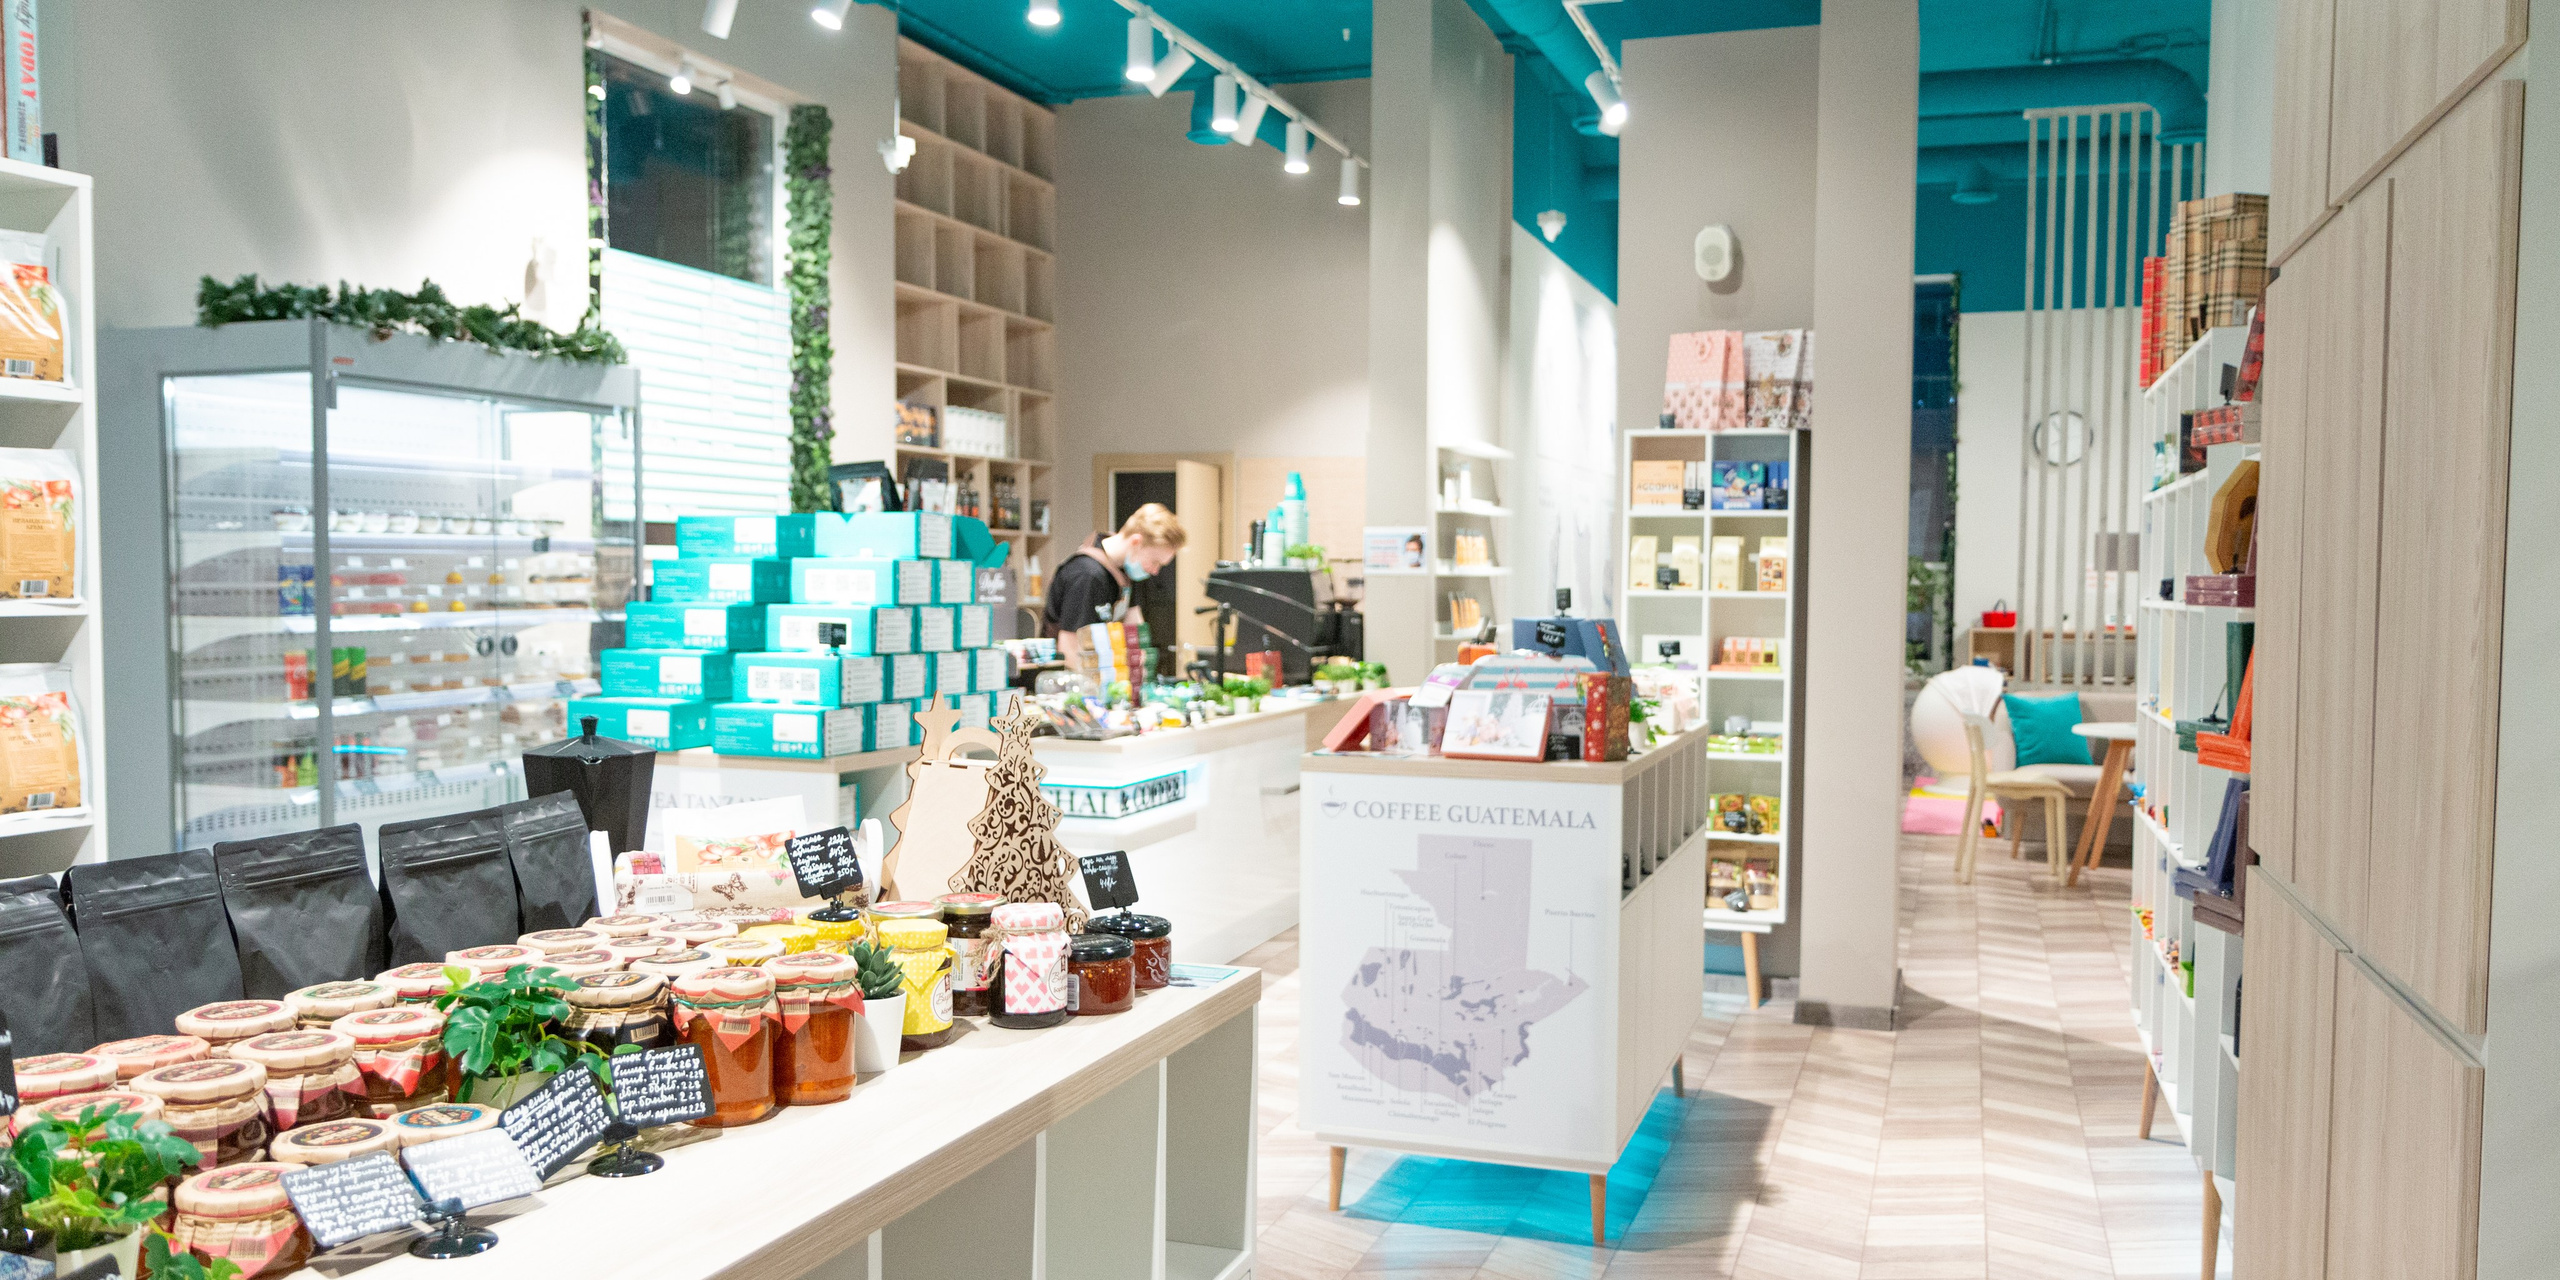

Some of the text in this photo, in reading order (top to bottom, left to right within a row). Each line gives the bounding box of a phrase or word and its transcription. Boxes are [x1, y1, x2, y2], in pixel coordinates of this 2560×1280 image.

[19, 30, 37, 101] TODAY
[1353, 800, 1597, 830] COFFEE GUATEMALA
[681, 1080, 701, 1089] 228
[581, 1085, 597, 1101] 228
[679, 1091, 702, 1102] 228
[585, 1108, 604, 1125] 228
